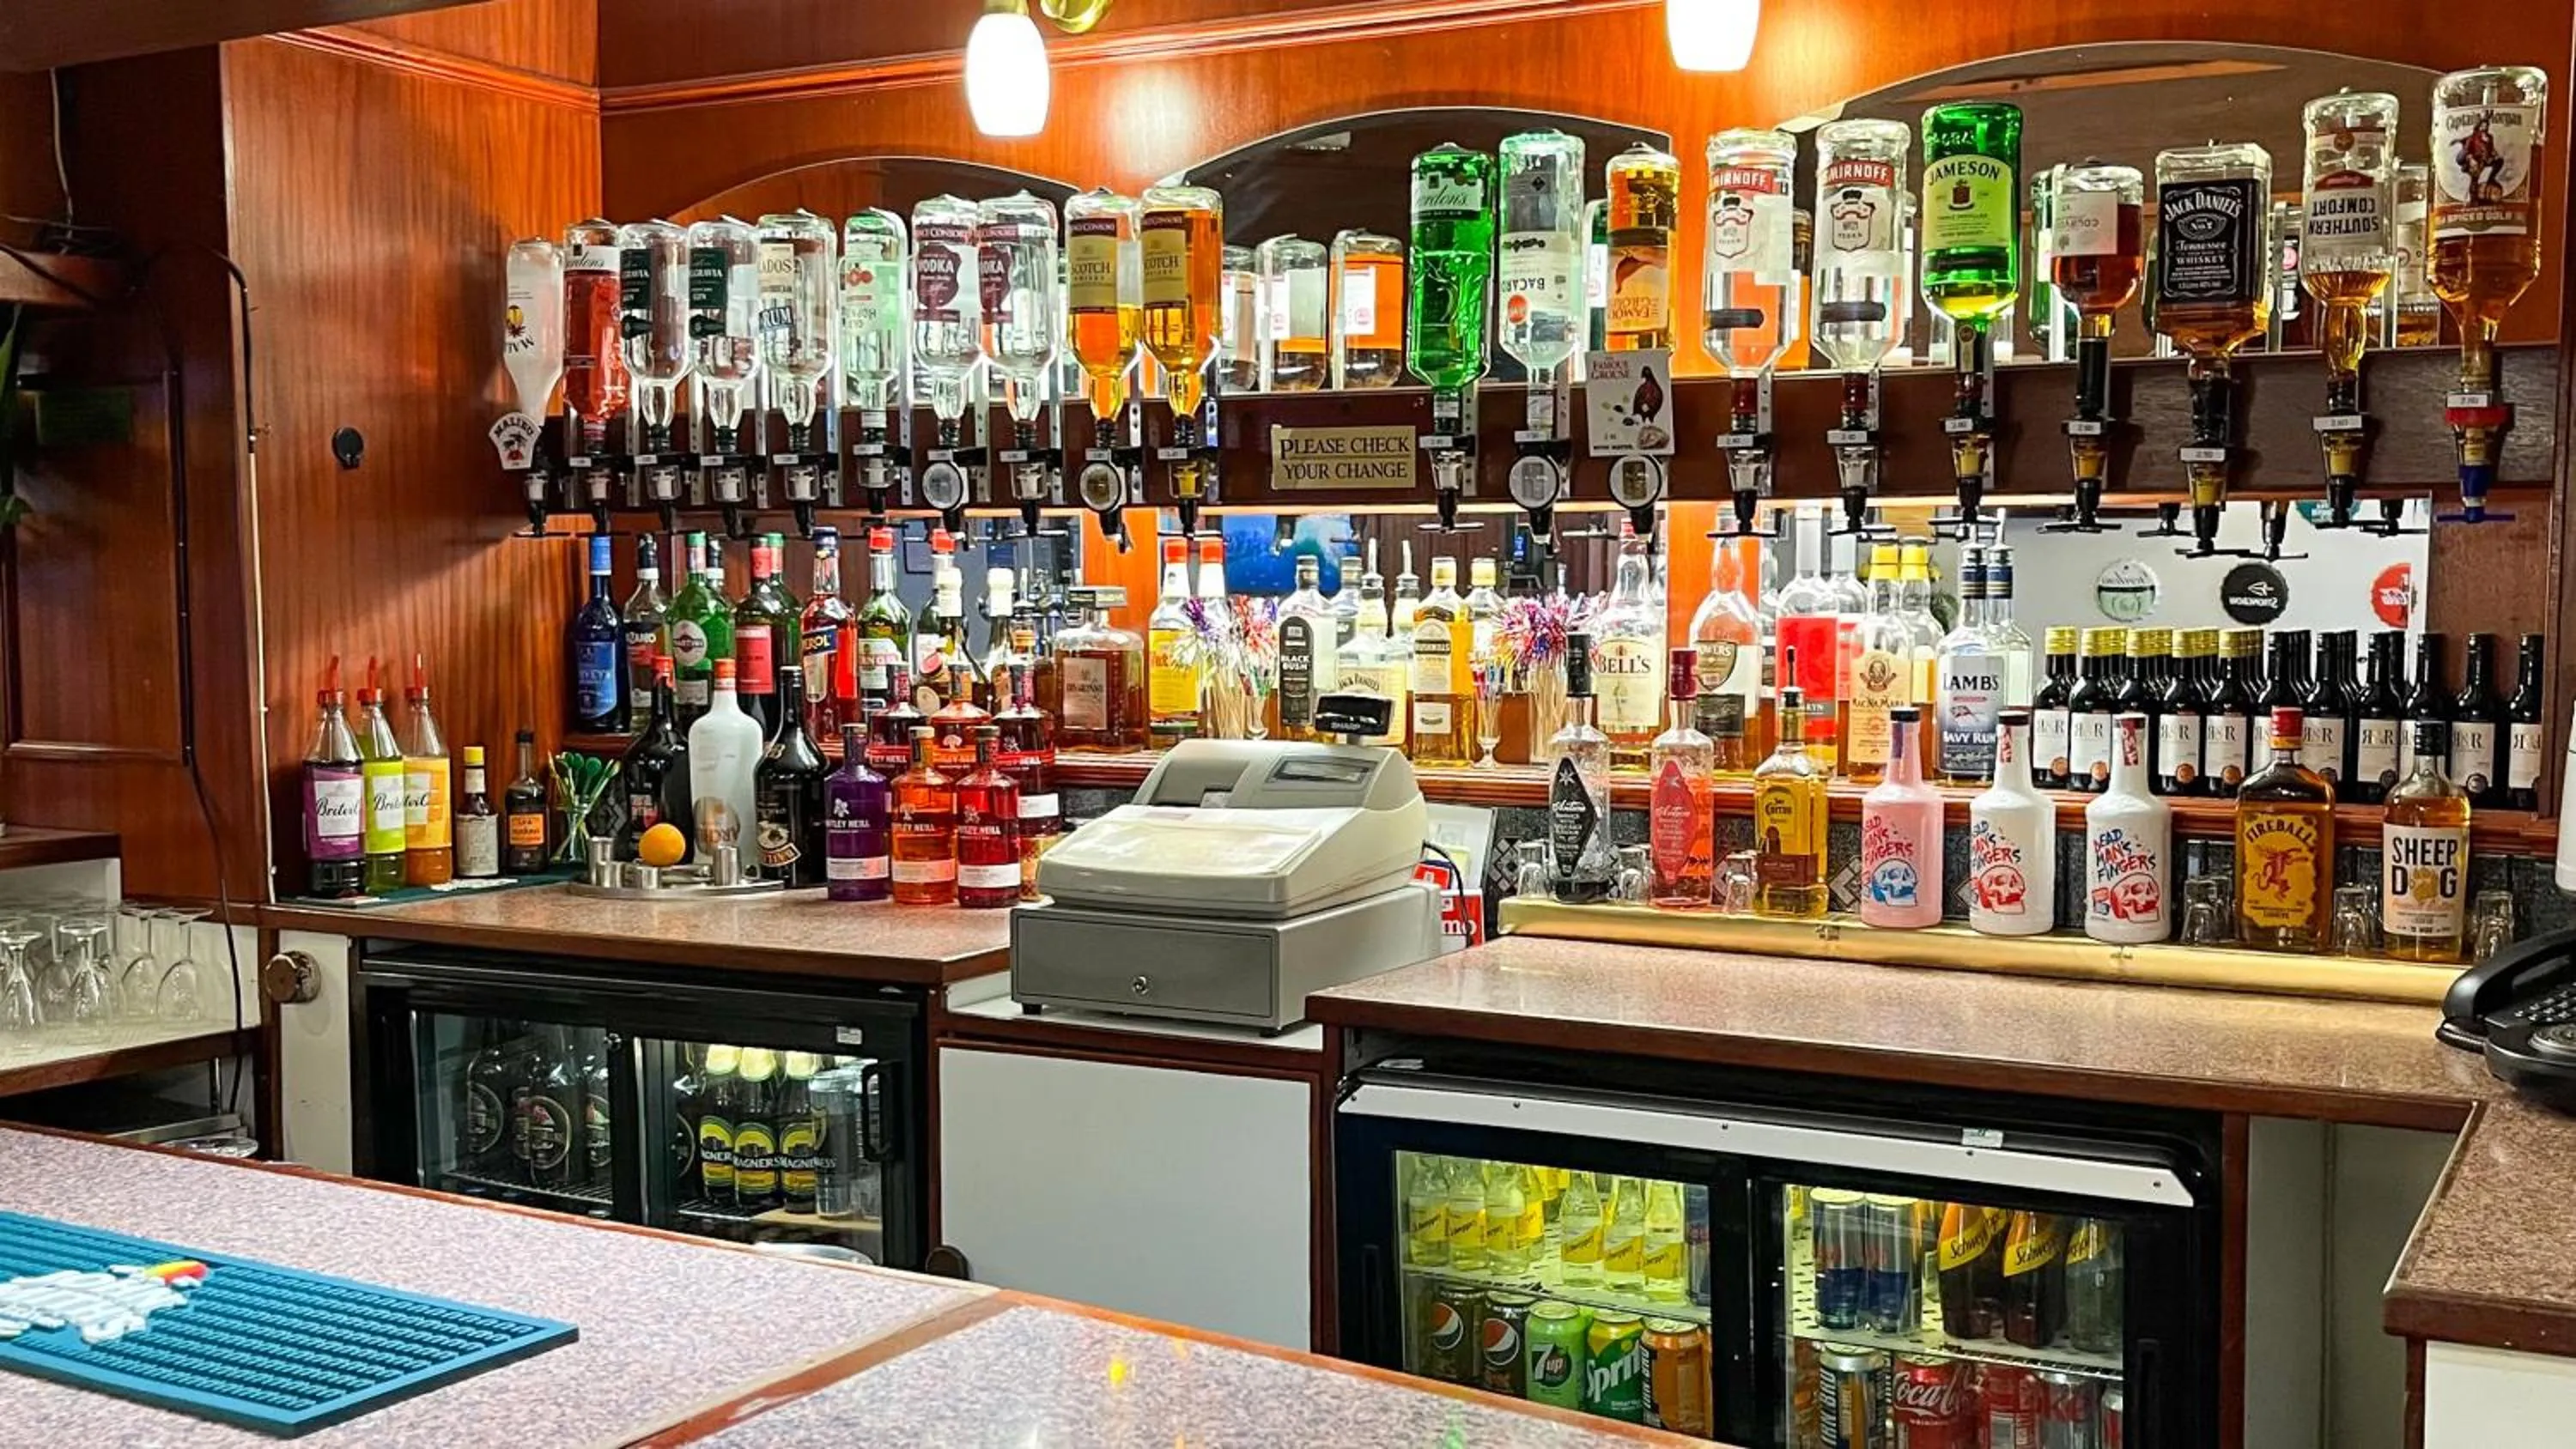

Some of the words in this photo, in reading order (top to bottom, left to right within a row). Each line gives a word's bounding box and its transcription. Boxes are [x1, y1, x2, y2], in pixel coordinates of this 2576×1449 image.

[1712, 172, 1766, 187] MIRNOFF
[1826, 163, 1887, 182] MIRNOFF
[1929, 161, 2001, 186] JAMESON
[2165, 197, 2196, 222] JACK
[2196, 191, 2243, 219] DANIEL'S
[2312, 197, 2377, 216] COMFORT
[2308, 216, 2379, 235] SOUTHERN
[762, 306, 793, 328] RUM
[1279, 437, 1346, 460] PLEASE
[1350, 436, 1411, 454] CHECK
[1283, 462, 1331, 480] YOUR
[1335, 461, 1408, 479] CHANGE
[1280, 655, 1310, 664] BLACK
[1282, 663, 1309, 671] BUSH
[1599, 655, 1652, 676] BELL'S
[1942, 673, 2000, 691] LAMB'S
[1331, 721, 1361, 731] SHARP
[2093, 828, 2123, 853] DEAD
[2245, 818, 2316, 854] FIREBALL
[2096, 840, 2132, 869] MAN'S
[2391, 835, 2459, 866] SHEEP
[2097, 852, 2157, 882] FINGERS
[1587, 1339, 1641, 1404] Sprit
